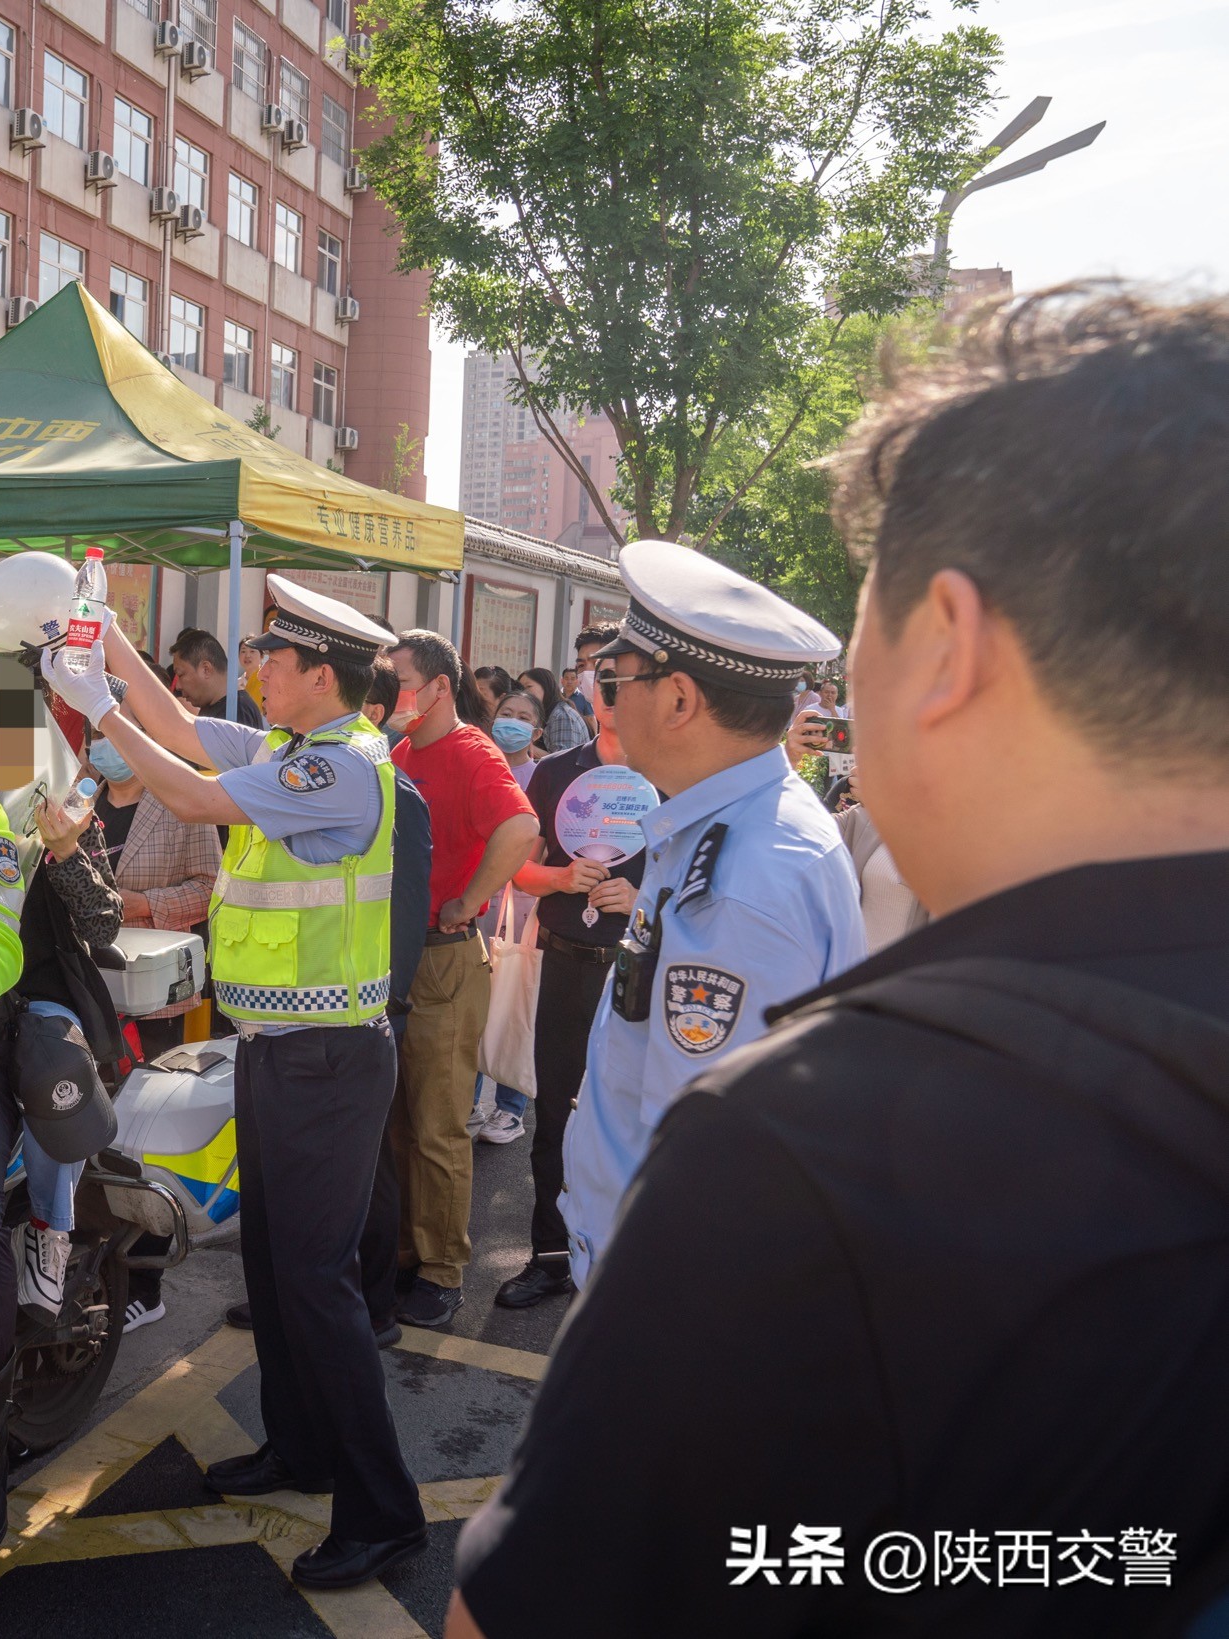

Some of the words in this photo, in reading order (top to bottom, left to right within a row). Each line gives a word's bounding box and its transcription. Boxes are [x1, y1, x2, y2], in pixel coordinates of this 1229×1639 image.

[316, 504, 416, 552] 专业健康营养品
[248, 888, 284, 900] POLICE
[668, 969, 741, 995] 中华人民共和国
